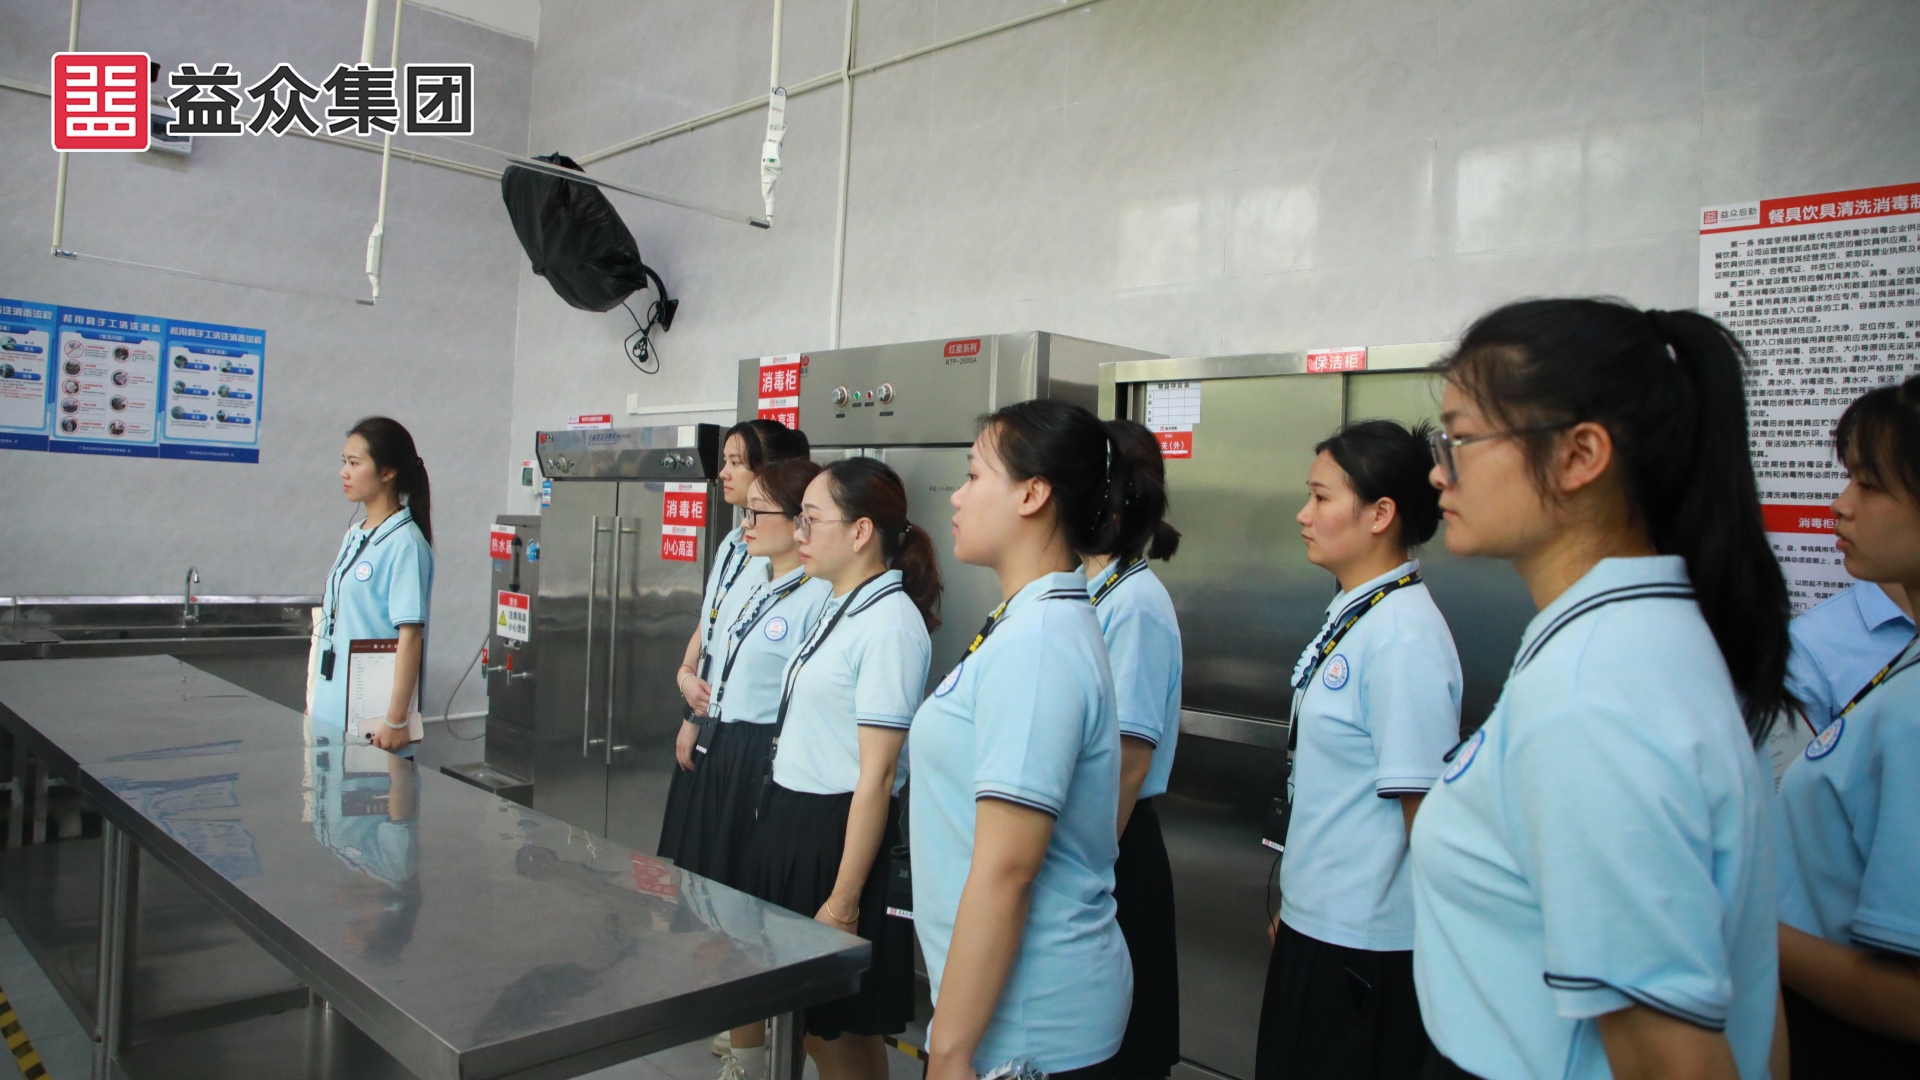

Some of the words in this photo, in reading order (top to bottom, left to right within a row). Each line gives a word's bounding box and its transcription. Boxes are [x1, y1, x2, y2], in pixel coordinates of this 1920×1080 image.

[1720, 207, 1757, 219] 益众后勤
[0, 305, 53, 320] 洗消毒流程
[1314, 353, 1358, 371] 保洁柜
[762, 369, 797, 393] 消毒柜
[666, 499, 703, 519] 消毒柜
[1798, 517, 1838, 529] 消毒柜
[663, 538, 694, 557] 小心高温
